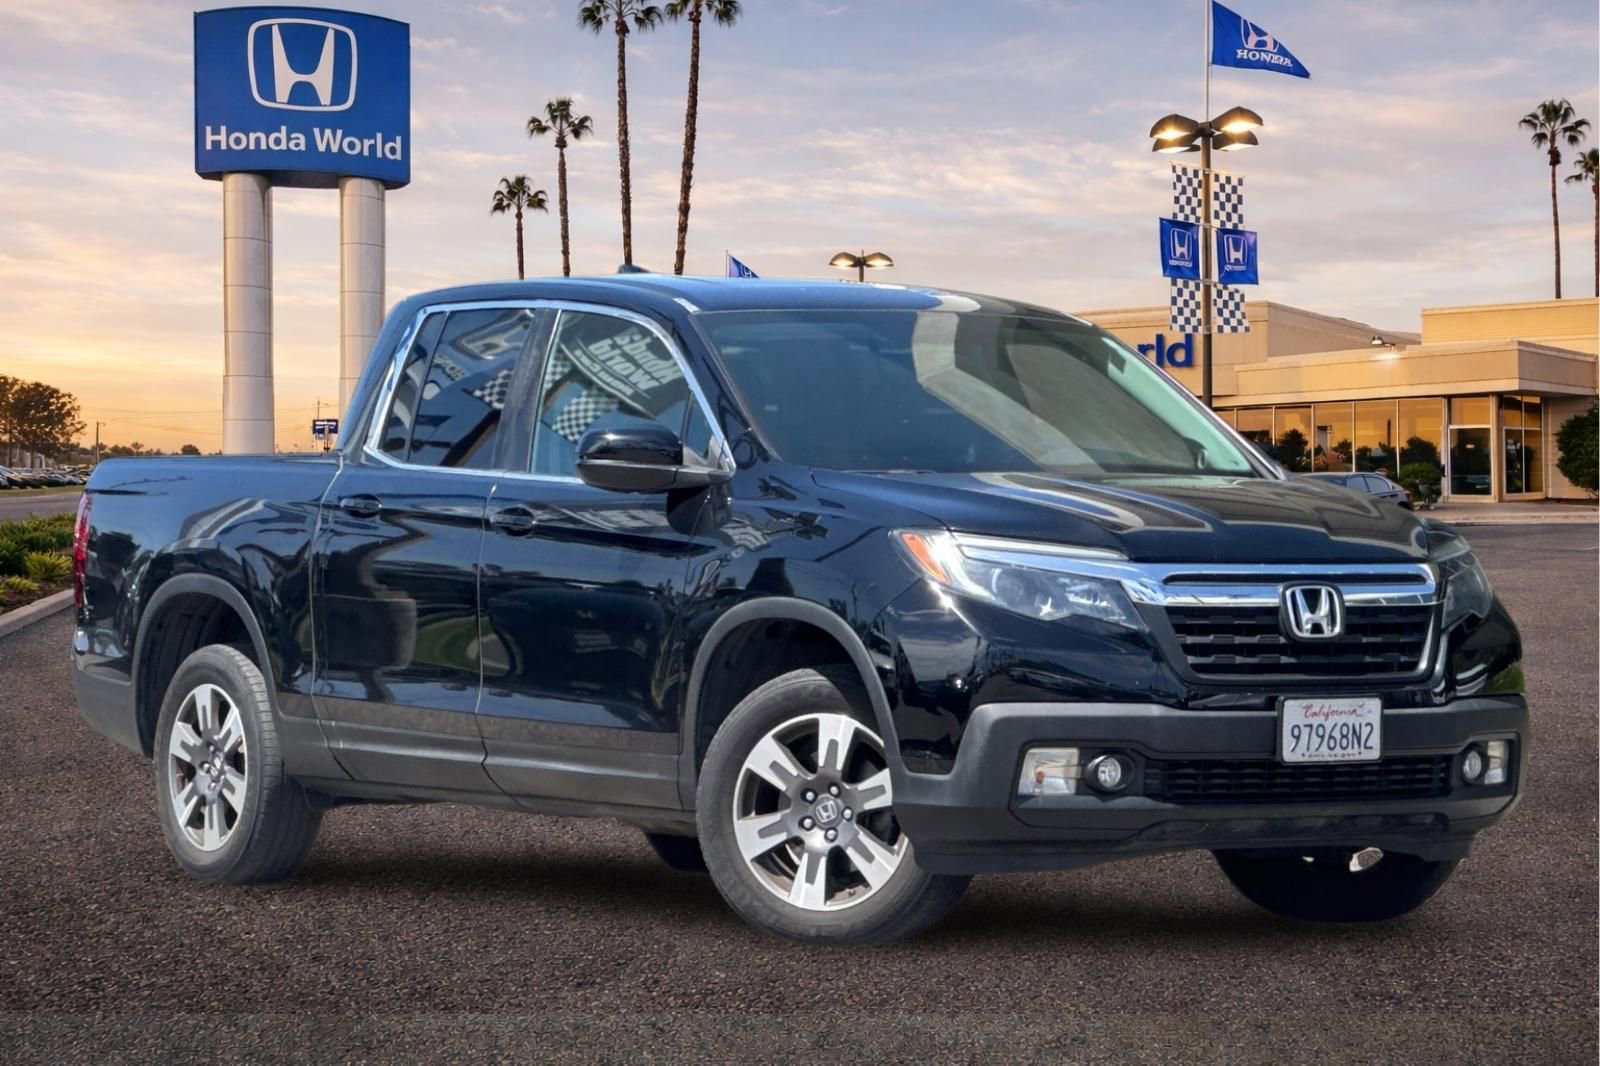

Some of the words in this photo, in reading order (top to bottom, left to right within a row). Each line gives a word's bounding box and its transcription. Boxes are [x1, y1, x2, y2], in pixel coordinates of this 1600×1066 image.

[1236, 49, 1293, 67] HONDA
[205, 125, 306, 151] Honda
[313, 127, 402, 161] World
[1302, 704, 1362, 721] California
[1290, 722, 1374, 752] 97968N2
